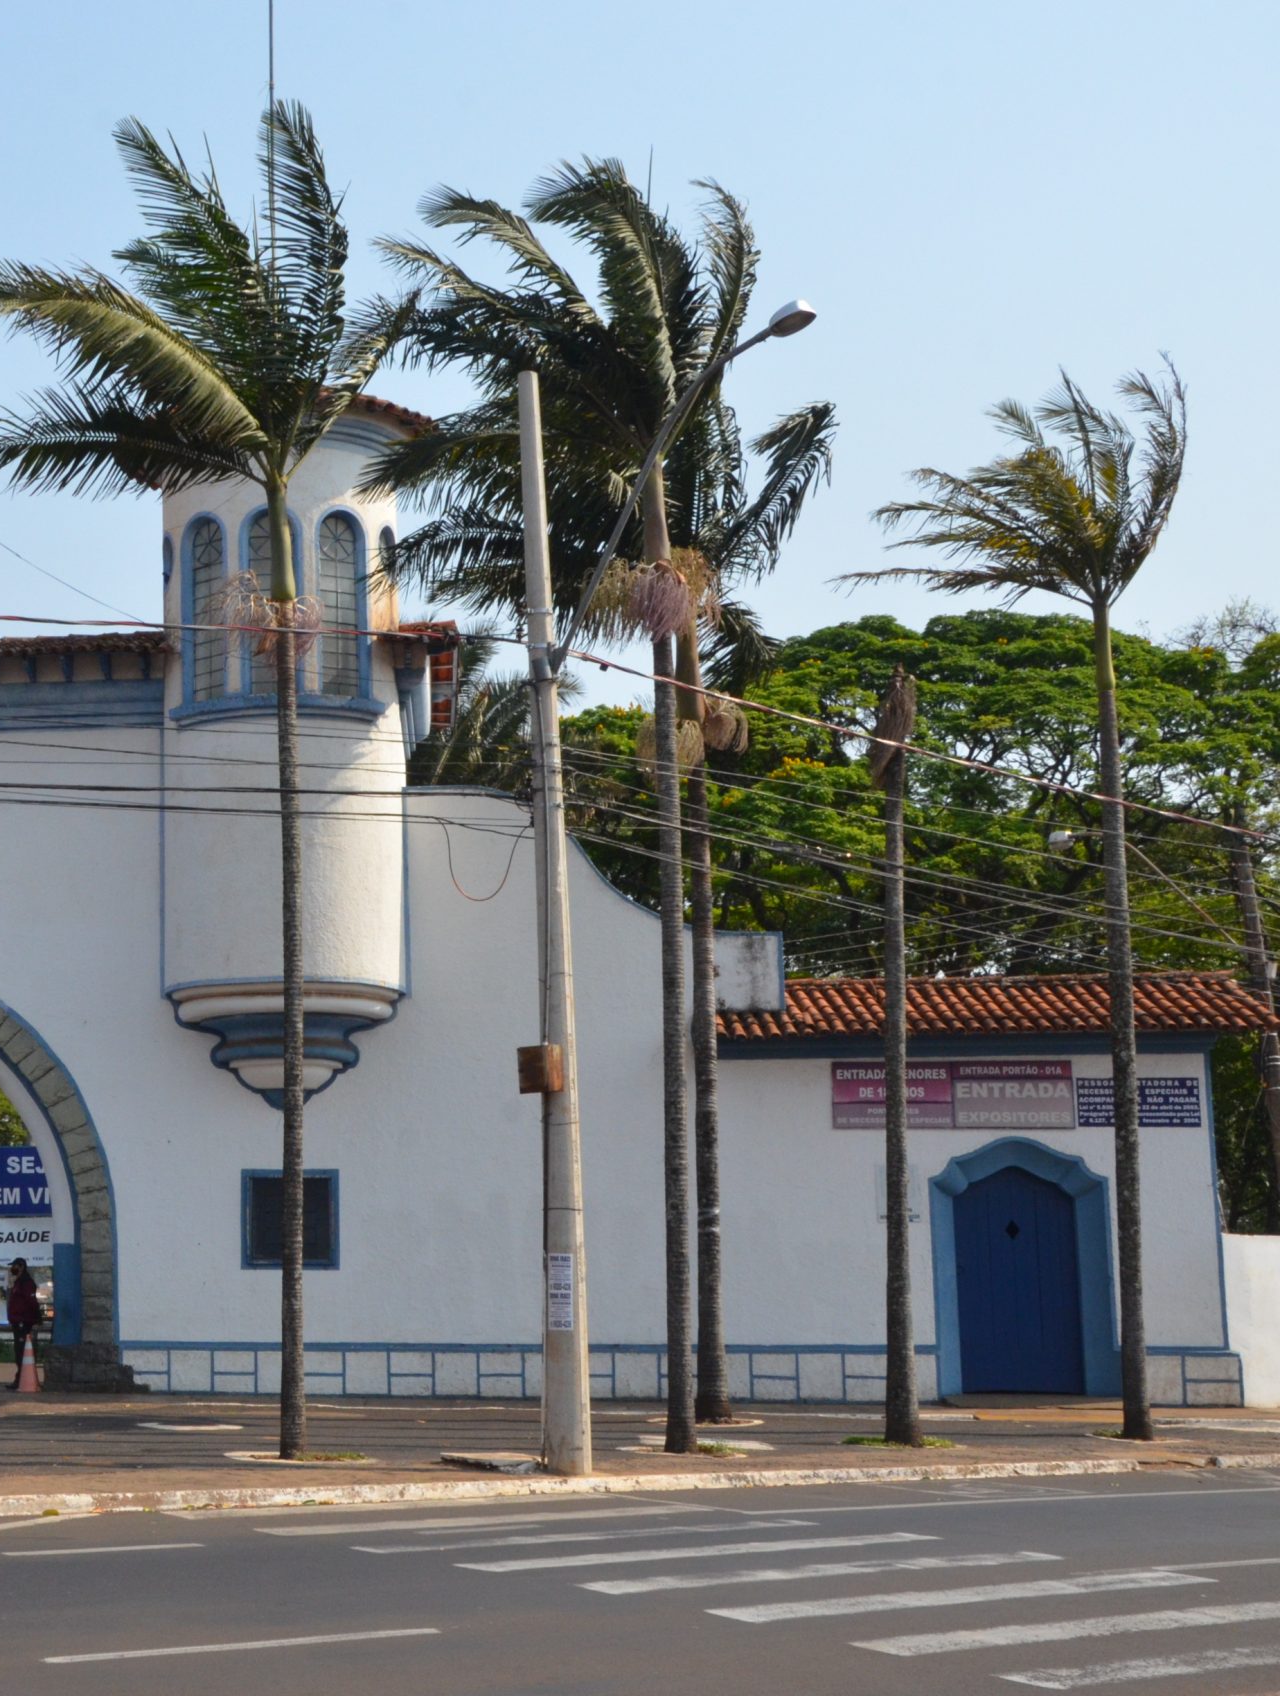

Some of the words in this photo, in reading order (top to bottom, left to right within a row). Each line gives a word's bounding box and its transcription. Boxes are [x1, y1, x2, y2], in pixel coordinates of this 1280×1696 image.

[904, 1068, 947, 1079] ENORES
[960, 1066, 1000, 1075] ENTRADA
[1002, 1064, 1038, 1075] PORTÃO
[1045, 1066, 1062, 1075] 01A
[859, 1086, 874, 1098] DE
[956, 1082, 1071, 1098] ENTRADA
[959, 1111, 1071, 1122] EXPOSITORES
[6, 1156, 44, 1174] SEJ
[28, 1187, 51, 1205] VI
